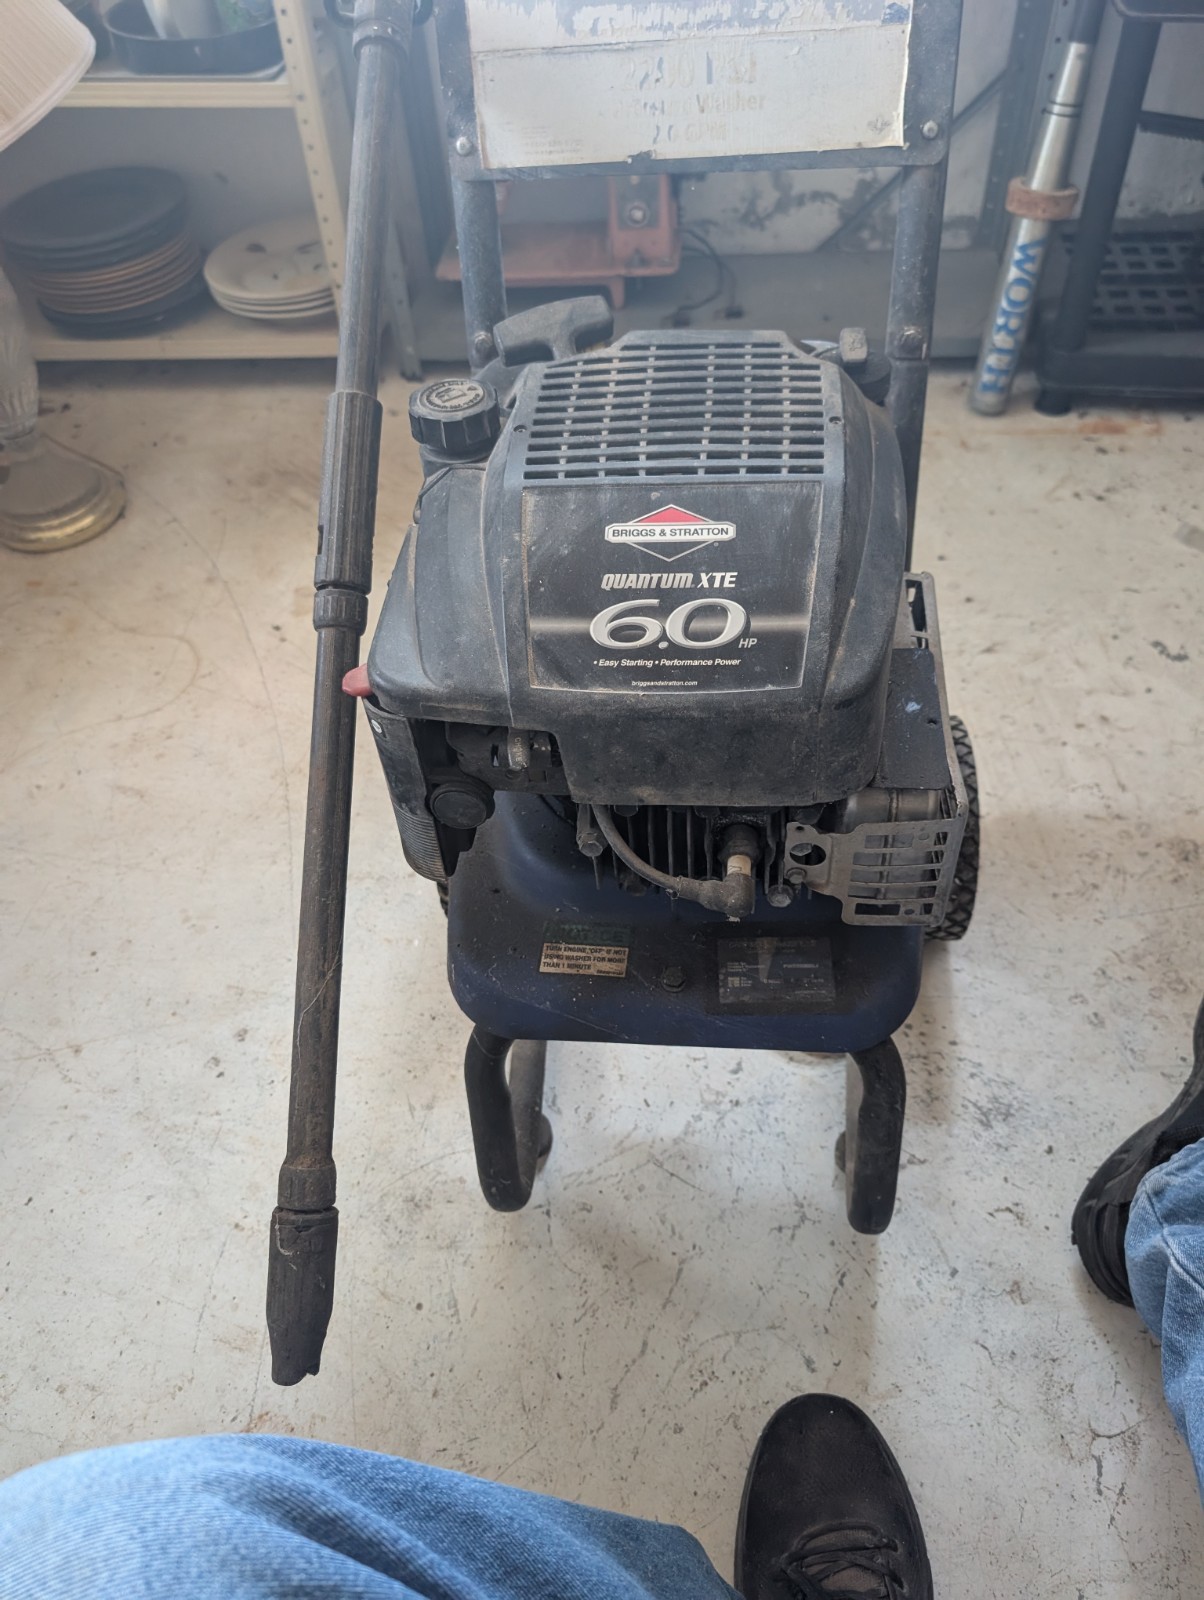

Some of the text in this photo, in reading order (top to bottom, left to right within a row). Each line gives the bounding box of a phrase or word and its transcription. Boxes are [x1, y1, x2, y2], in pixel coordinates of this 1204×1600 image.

[612, 527, 729, 537] BRIGGS & STRATTON
[601, 572, 738, 590] QUANTUM XTE
[589, 598, 757, 650] 6.0 HP
[599, 658, 741, 667] Easy Starting Performance Power
